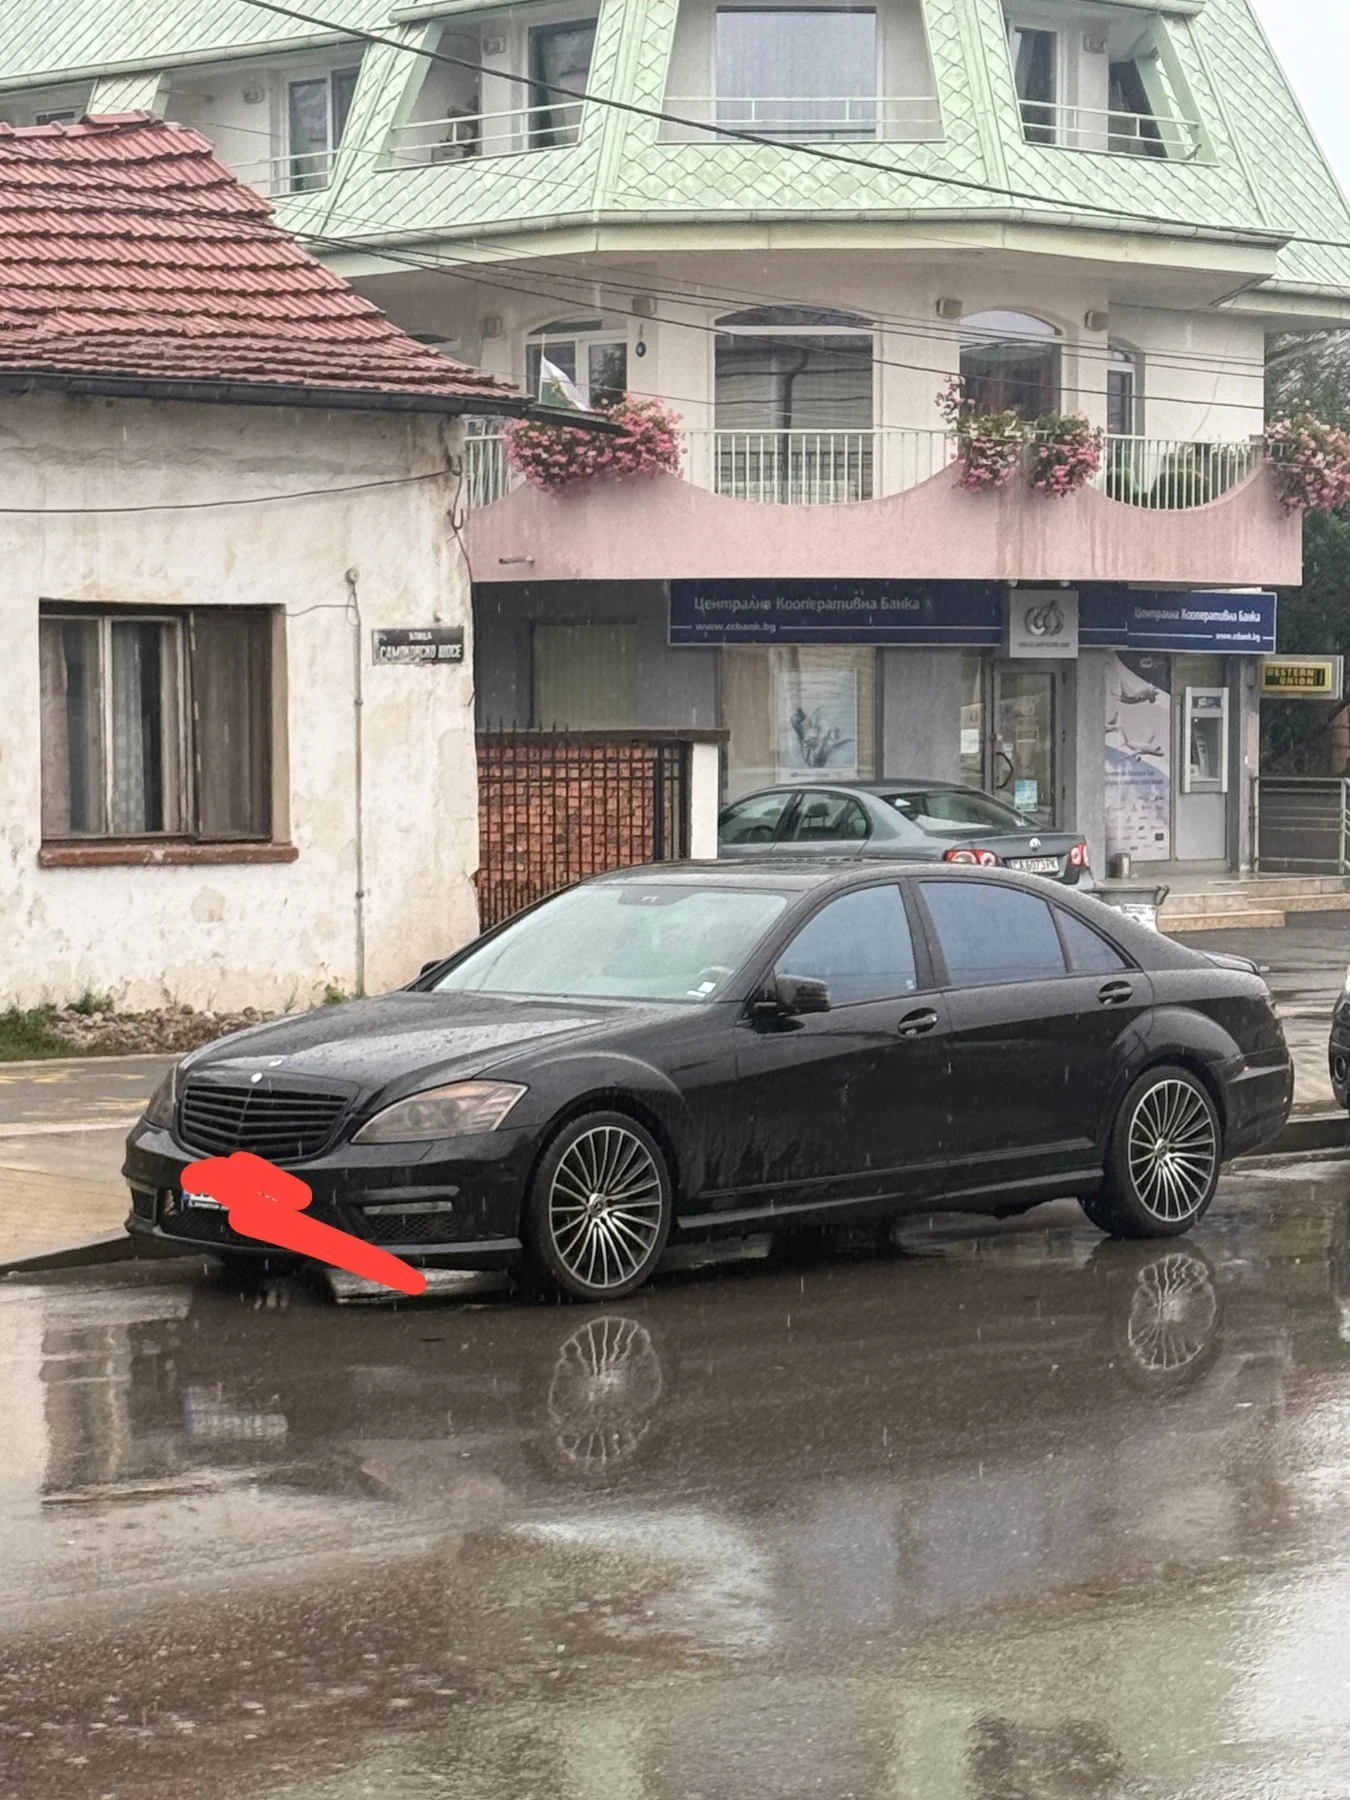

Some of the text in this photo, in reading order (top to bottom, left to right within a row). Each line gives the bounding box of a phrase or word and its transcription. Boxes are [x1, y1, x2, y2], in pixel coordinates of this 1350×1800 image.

[776, 596, 877, 613] Кооперативна
[881, 596, 921, 611] Банка
[1238, 610, 1261, 623] Банка
[695, 622, 777, 634] www.ccbank.bg
[1266, 668, 1314, 677] WESTERN
[1280, 677, 1314, 685] UNION
